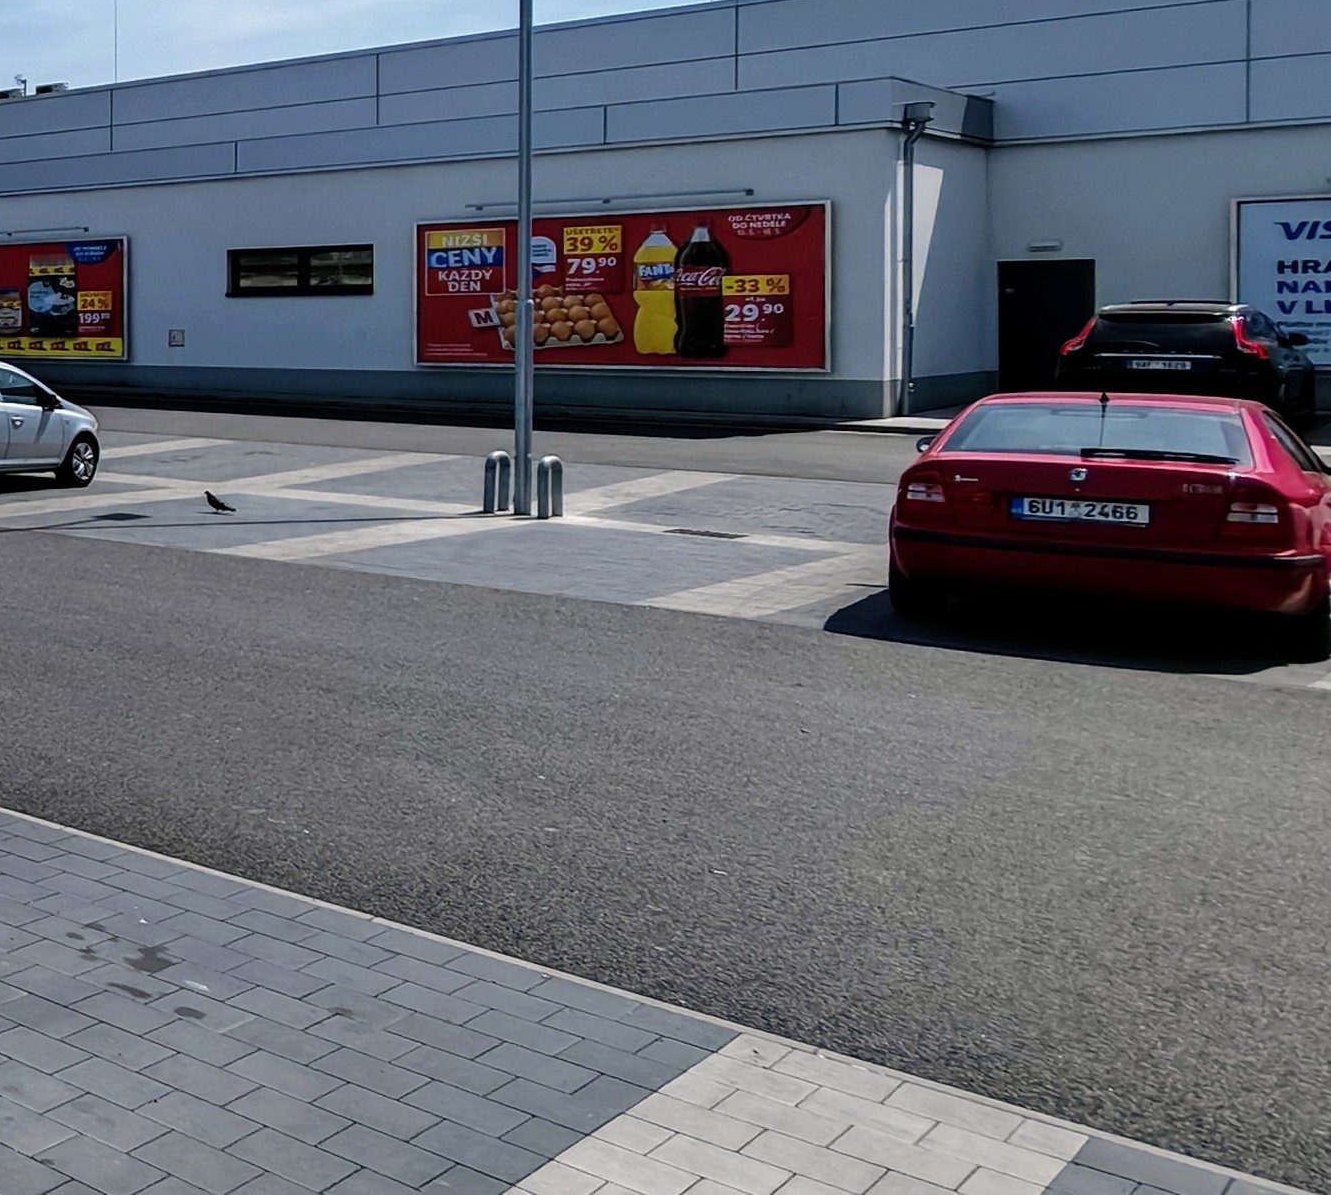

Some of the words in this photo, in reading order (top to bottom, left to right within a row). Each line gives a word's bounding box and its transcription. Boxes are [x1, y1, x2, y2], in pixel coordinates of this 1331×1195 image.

[566, 236, 593, 252] 39
[598, 235, 618, 251] %
[431, 247, 497, 267] CENY
[448, 281, 481, 292] DEN
[766, 278, 785, 293] %
[81, 298, 96, 308] 24
[473, 310, 494, 325] M
[1027, 500, 1066, 516] 6U1
[1083, 500, 1139, 520] 2466
